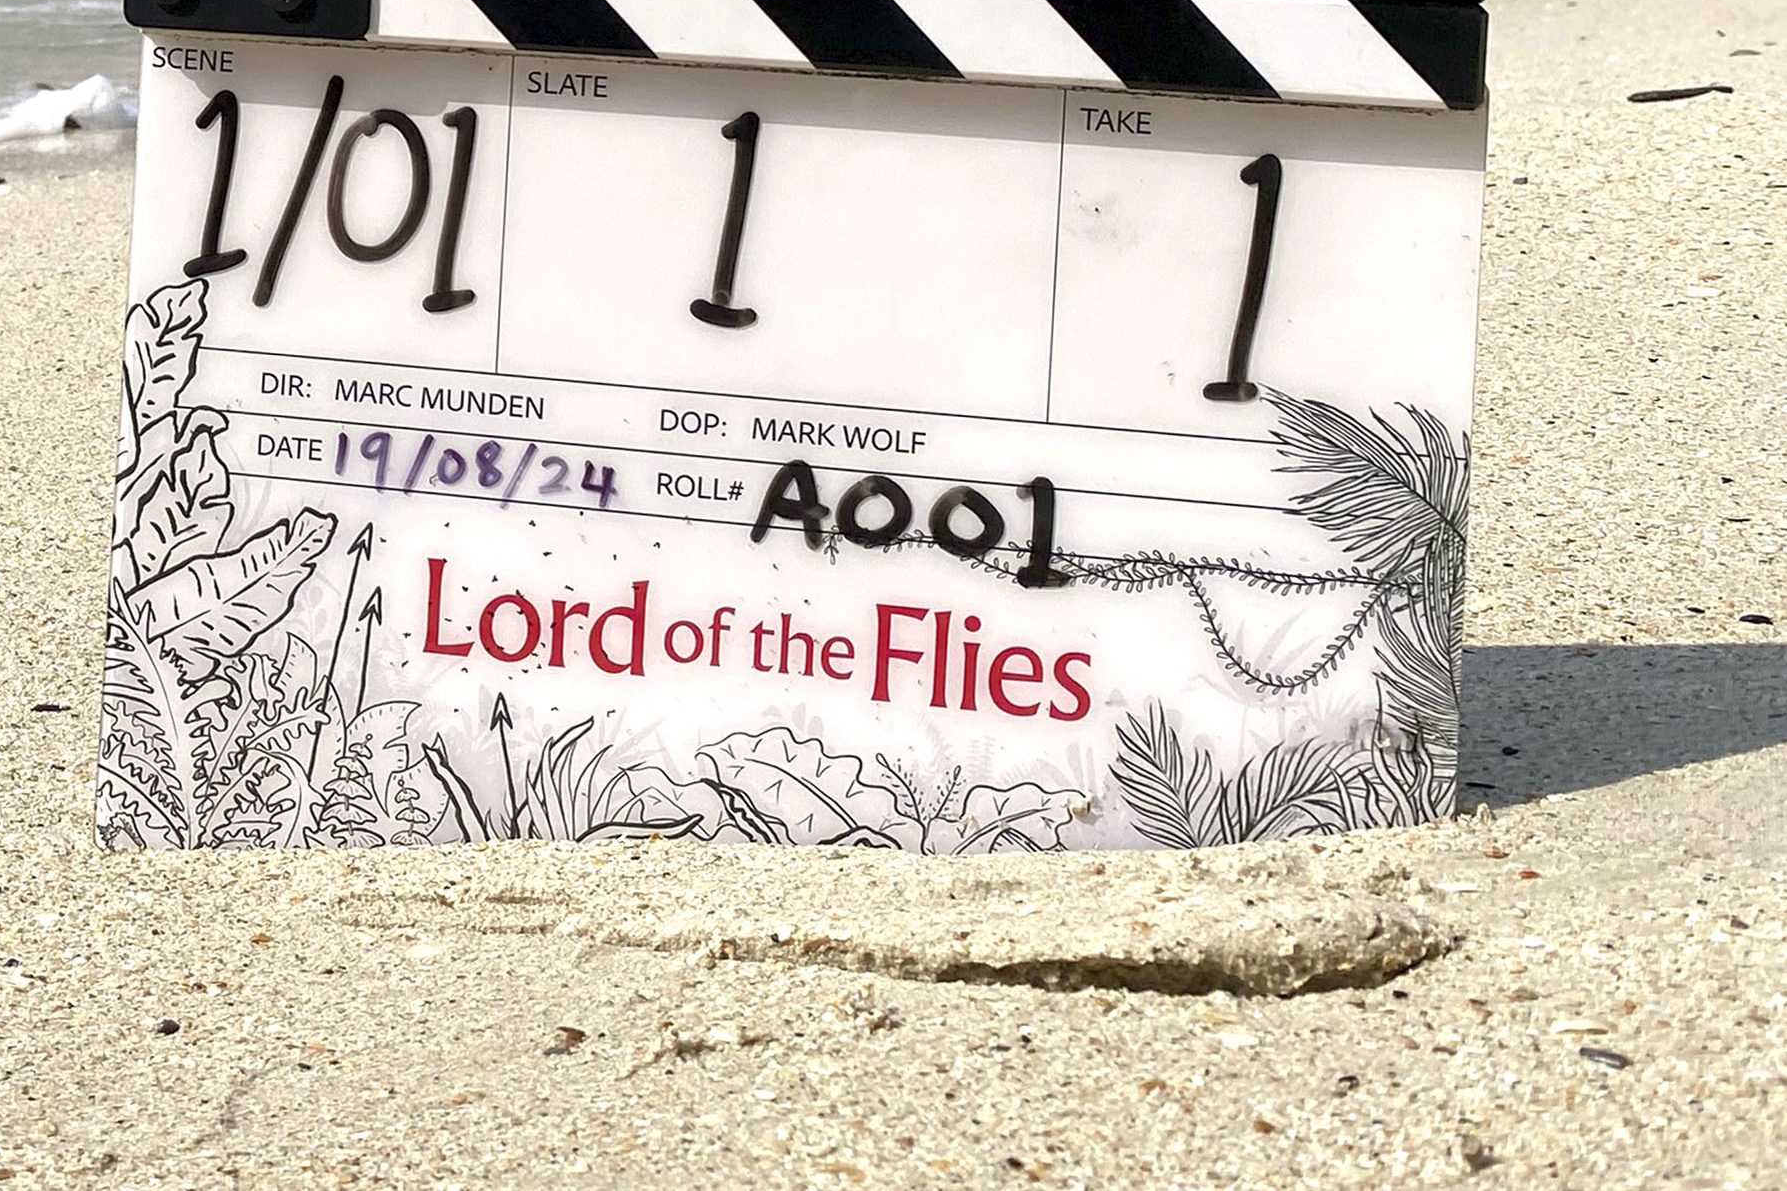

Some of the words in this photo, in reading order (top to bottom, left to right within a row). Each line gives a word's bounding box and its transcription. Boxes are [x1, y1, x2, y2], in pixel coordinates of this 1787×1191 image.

[152, 46, 234, 73] SCENE
[526, 71, 608, 99] SLATE
[1080, 108, 1152, 136] TAKE
[183, 75, 477, 313] 1/01
[689, 111, 759, 328] 1
[1202, 153, 1282, 402] 1
[260, 372, 312, 398] DIR:
[335, 379, 412, 407] MARC
[421, 387, 545, 420] MUNDEN
[257, 434, 323, 461] DATE
[659, 409, 727, 437] DOP:
[752, 417, 836, 447] MARK
[843, 426, 927, 454] WOLF
[335, 431, 617, 509] 19/08/24
[656, 473, 744, 501] ROLL#
[750, 459, 1069, 589] A001
[423, 558, 650, 676] Lord
[664, 607, 736, 667] of
[750, 612, 855, 680] the
[871, 603, 1092, 721] Flies
